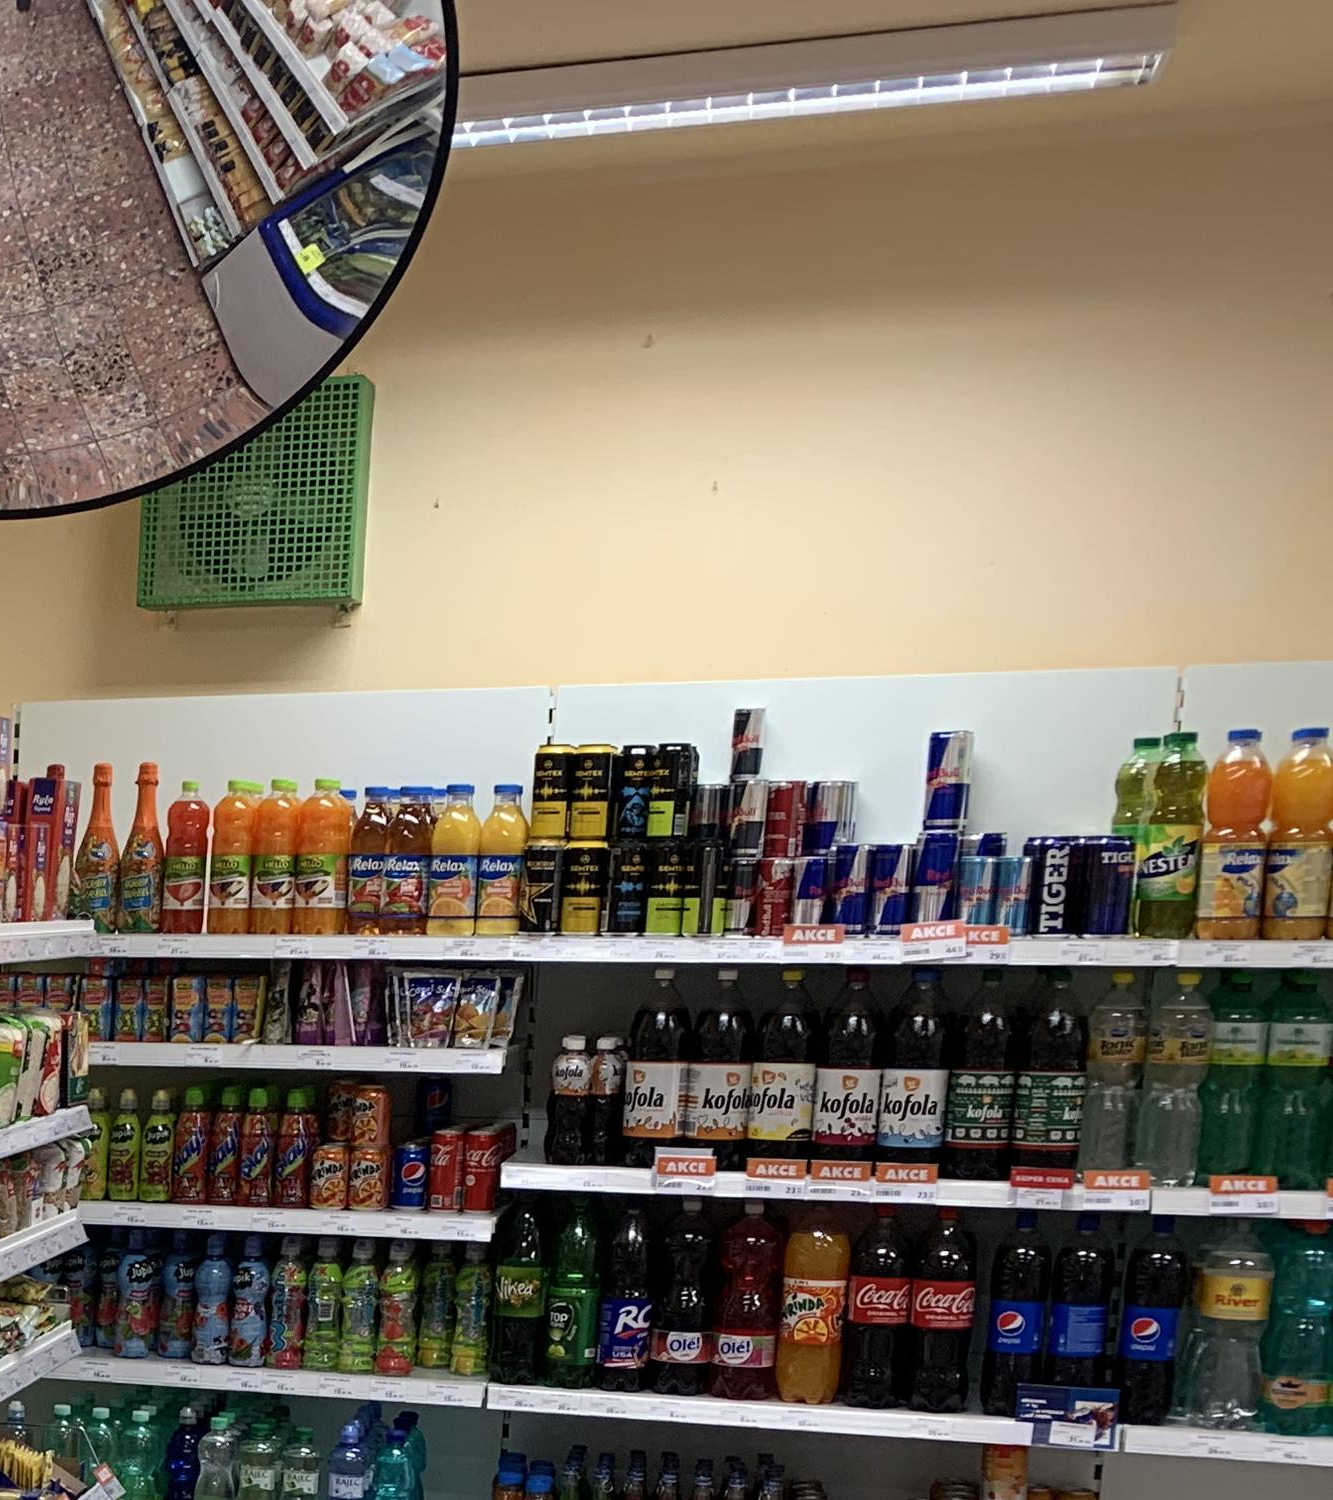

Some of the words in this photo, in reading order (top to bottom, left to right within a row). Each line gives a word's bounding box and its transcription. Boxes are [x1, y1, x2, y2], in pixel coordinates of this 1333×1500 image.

[1102, 851, 1133, 864] TIG
[1141, 854, 1196, 874] NESTEA
[387, 858, 420, 872] Relax
[432, 858, 466, 872] Relax
[482, 858, 515, 872] Relax
[1039, 845, 1071, 933] TIGER
[791, 928, 836, 941] AKCE
[910, 925, 955, 940] AKCE
[969, 931, 999, 942] KCE
[556, 1066, 583, 1081] kofola
[820, 1092, 874, 1119] kofola
[883, 1091, 937, 1121] kofola
[967, 1104, 1003, 1122] kofola
[665, 1161, 707, 1174] AKCE
[756, 1165, 797, 1177] AKCE
[820, 1166, 862, 1178] AKCE
[885, 1168, 929, 1181] AKCE
[1015, 1174, 1044, 1185] SUPER
[1047, 1174, 1070, 1184] CENA
[1094, 1174, 1141, 1188] AKCE
[1220, 1178, 1267, 1191] AKCE
[497, 1276, 533, 1299] Vinea
[1215, 1293, 1260, 1309] River
[670, 1338, 701, 1353] Olé!
[720, 1341, 751, 1355] Olé!
[244, 1470, 270, 1480] RAJEC
[287, 1473, 312, 1483] RAJEC
[335, 1477, 361, 1488] RAJEC
